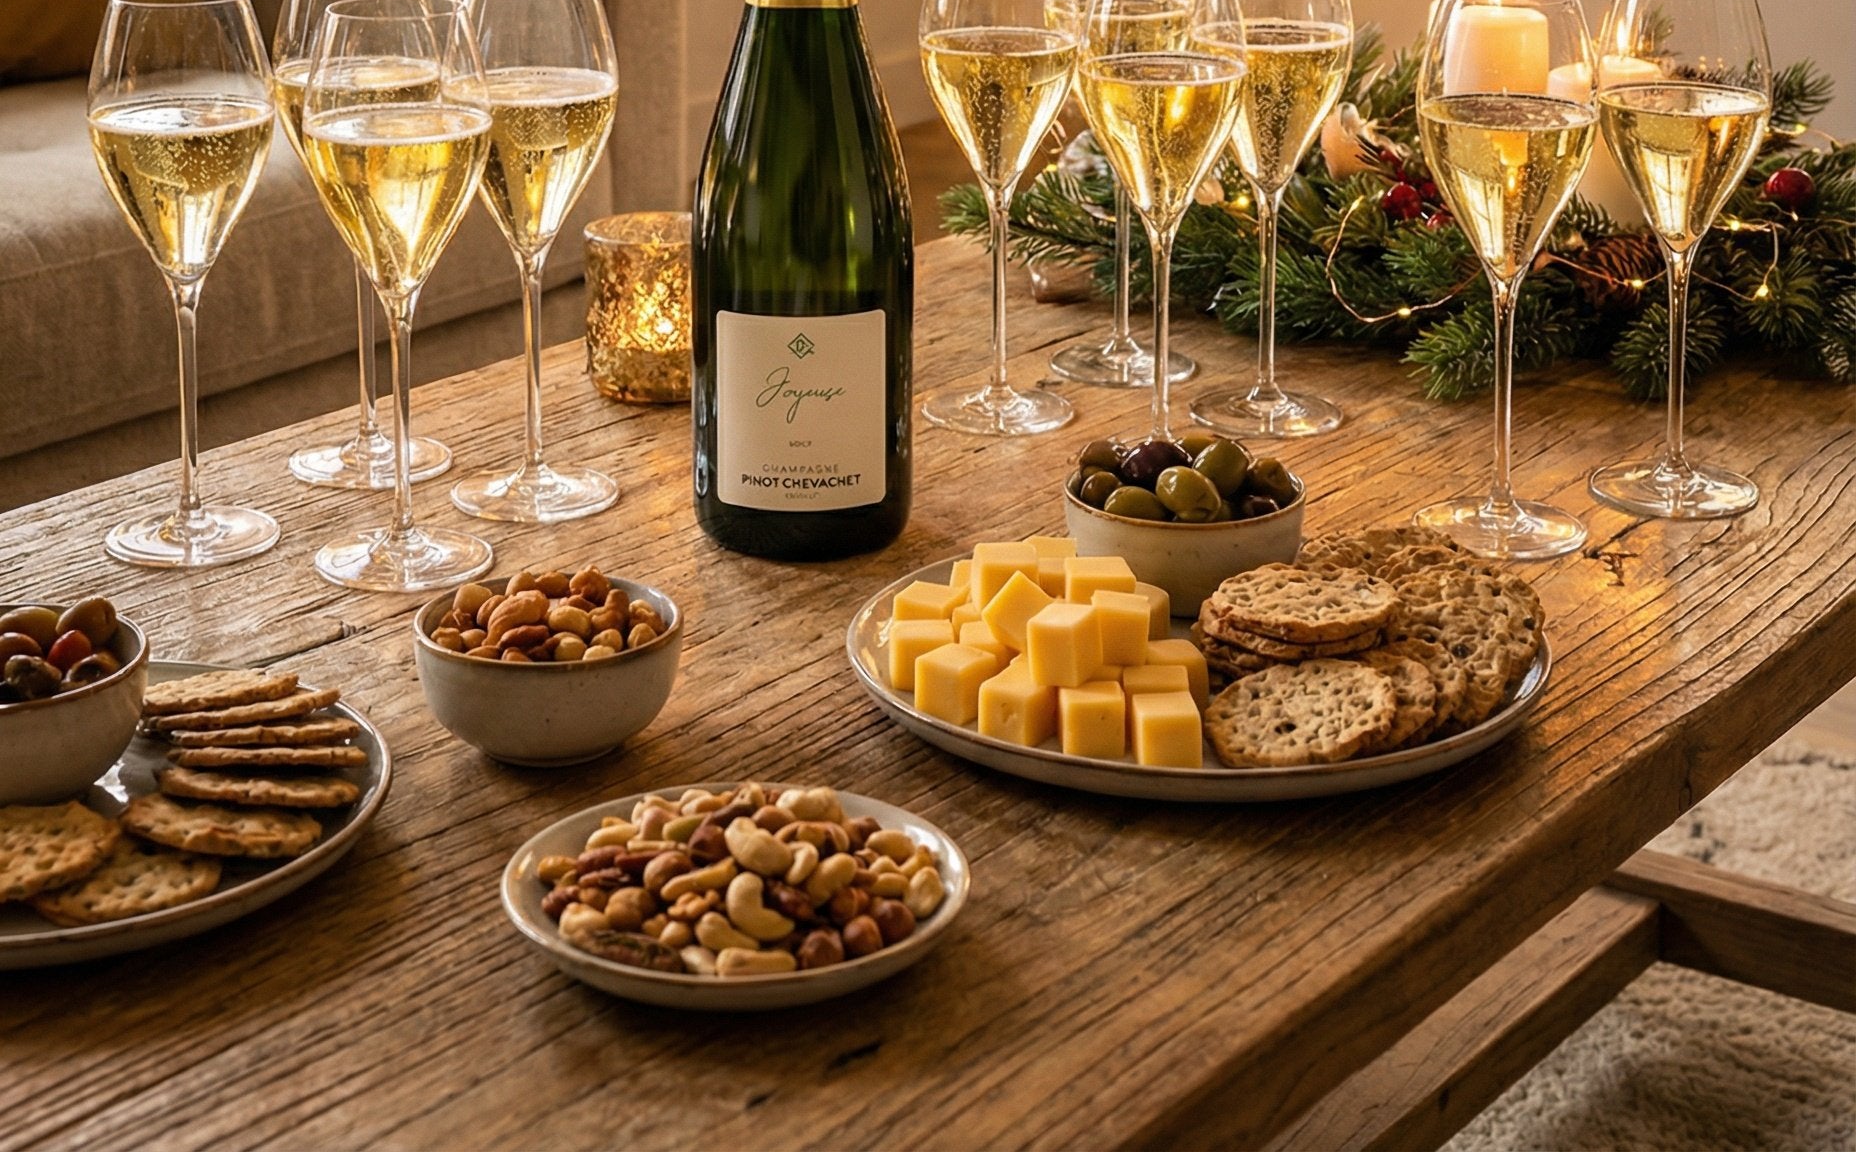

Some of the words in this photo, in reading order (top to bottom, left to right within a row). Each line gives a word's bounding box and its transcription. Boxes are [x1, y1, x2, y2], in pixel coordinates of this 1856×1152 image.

[762, 463, 839, 474] CHAMPAGNE
[741, 473, 780, 488] PINOT
[782, 473, 861, 489] CHEVACHET
